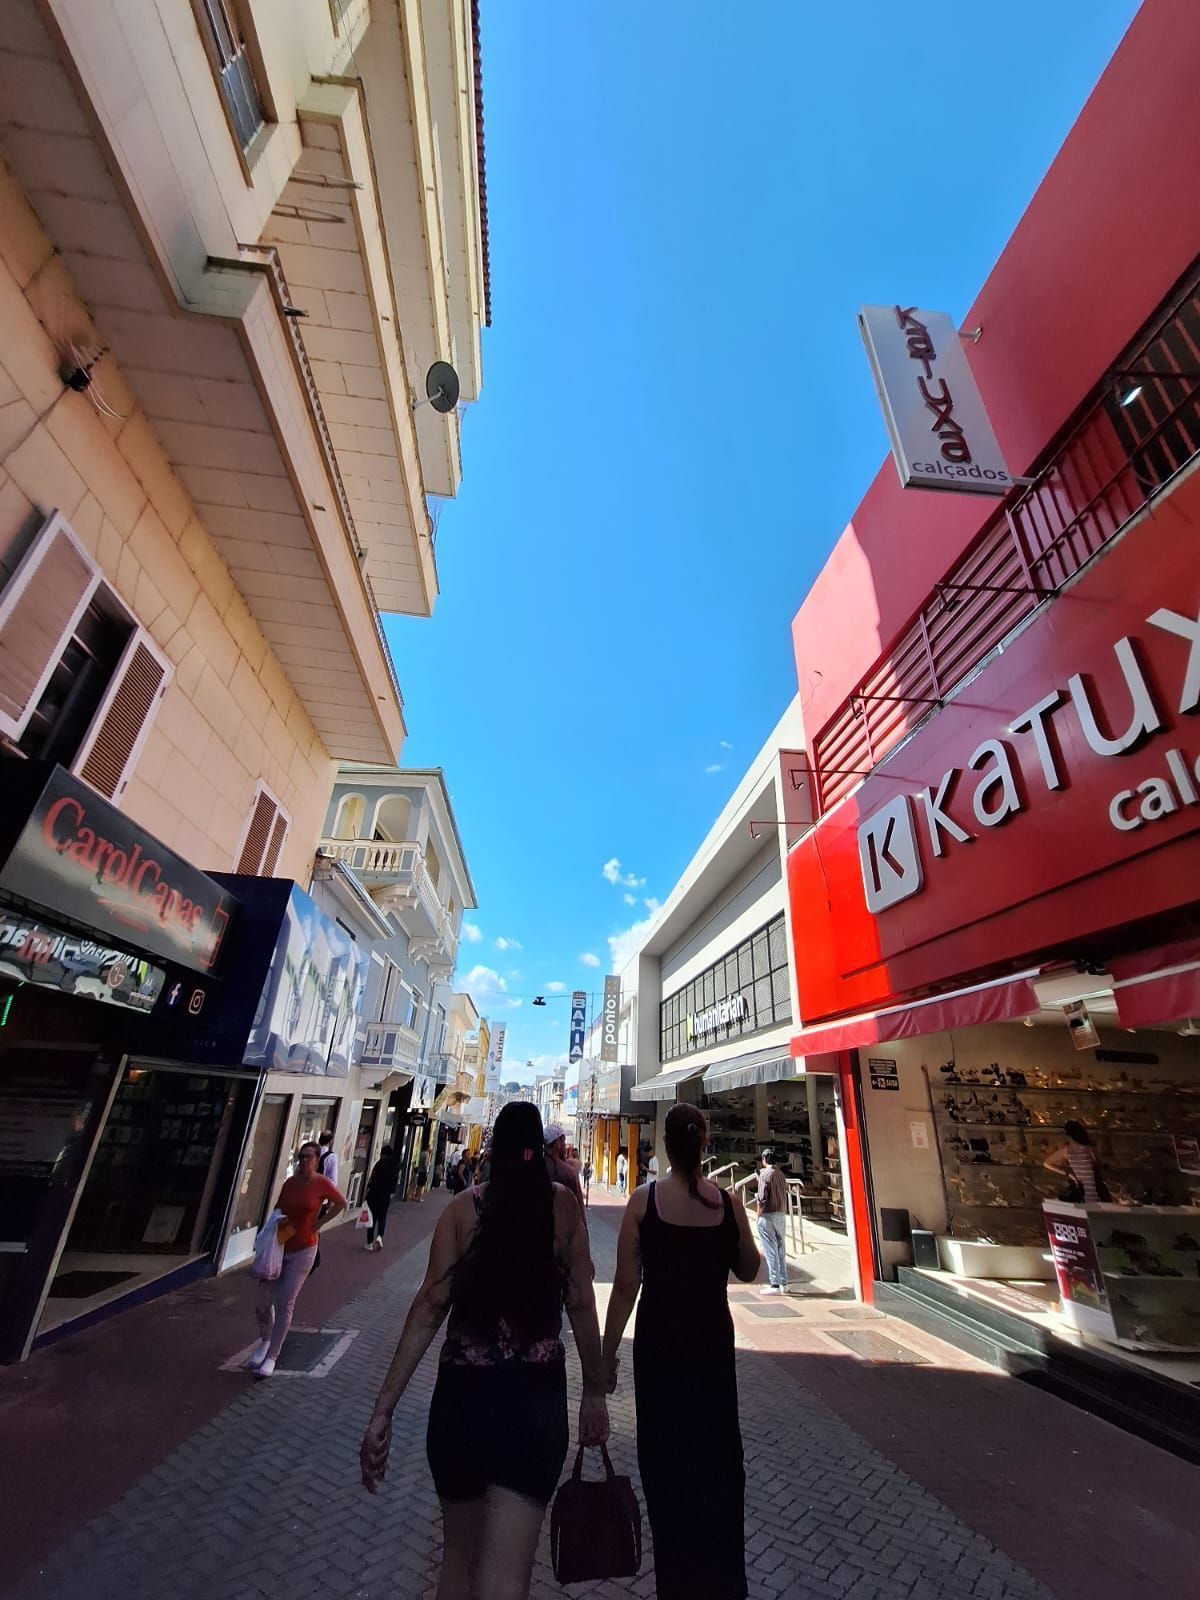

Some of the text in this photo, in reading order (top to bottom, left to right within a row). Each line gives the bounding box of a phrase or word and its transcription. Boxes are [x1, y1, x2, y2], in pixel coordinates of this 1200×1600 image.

[912, 461, 1009, 481] calçados
[1108, 748, 1200, 831] cal
[570, 998, 586, 1056] BAHIA
[693, 994, 746, 1036] humanitarian
[495, 1030, 505, 1063] Karina
